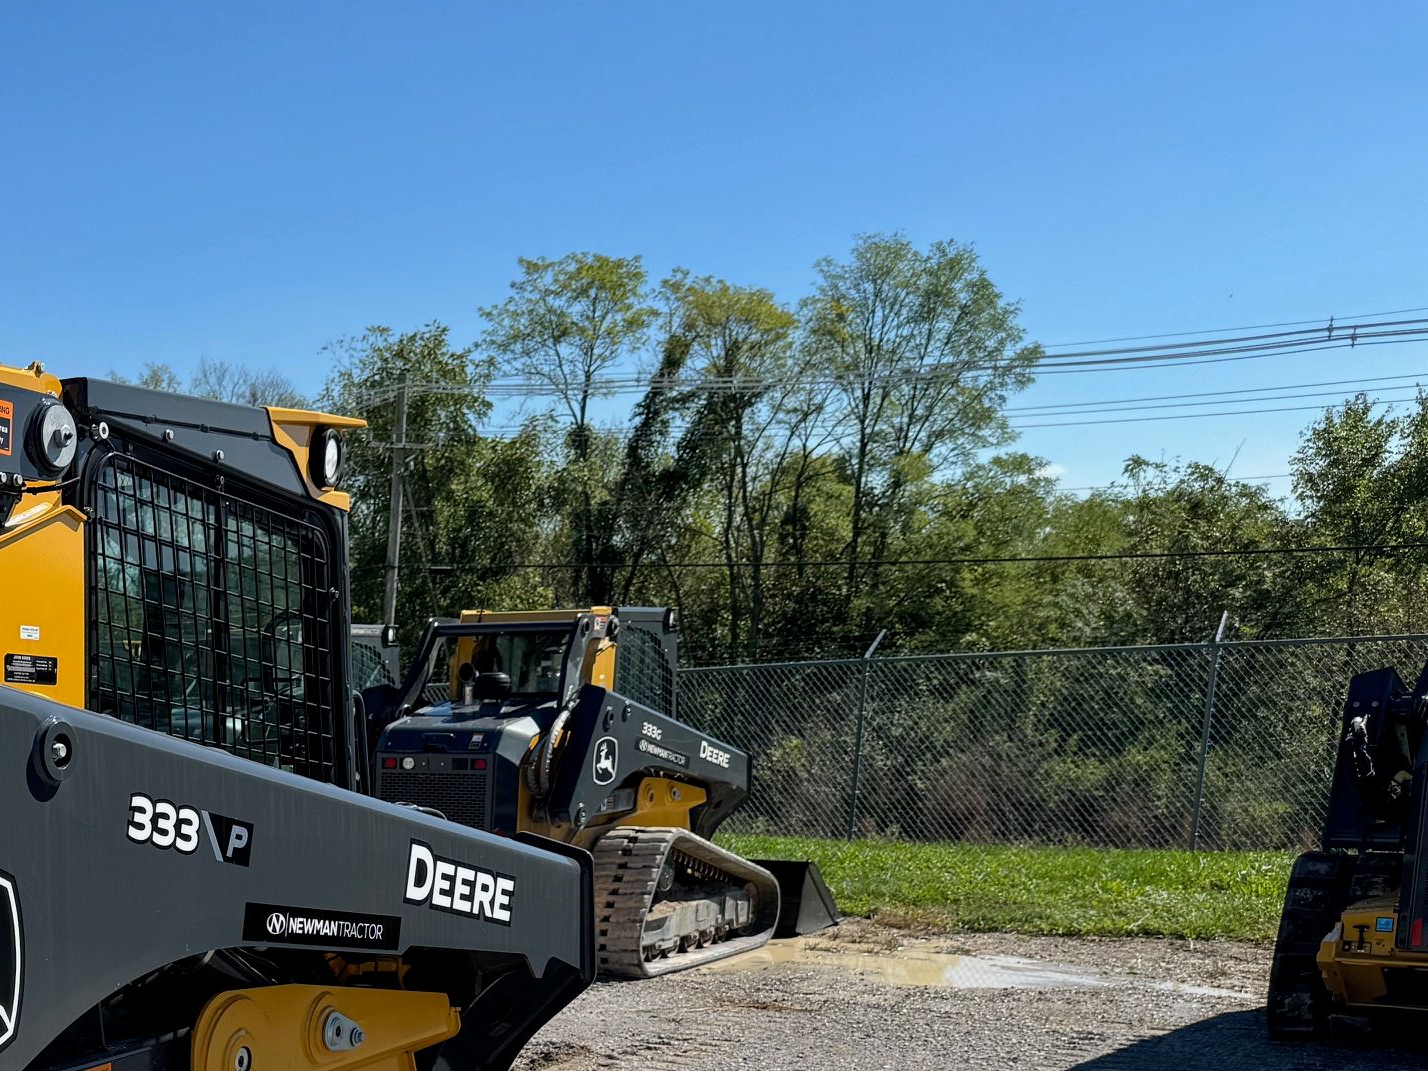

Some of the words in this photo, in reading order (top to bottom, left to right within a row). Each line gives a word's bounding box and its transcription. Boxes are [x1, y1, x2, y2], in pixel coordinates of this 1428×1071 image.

[642, 722, 662, 740] 333G
[699, 740, 730, 768] DEERE
[128, 796, 200, 852] 333
[226, 814, 249, 858] P
[406, 843, 515, 922] DEERE
